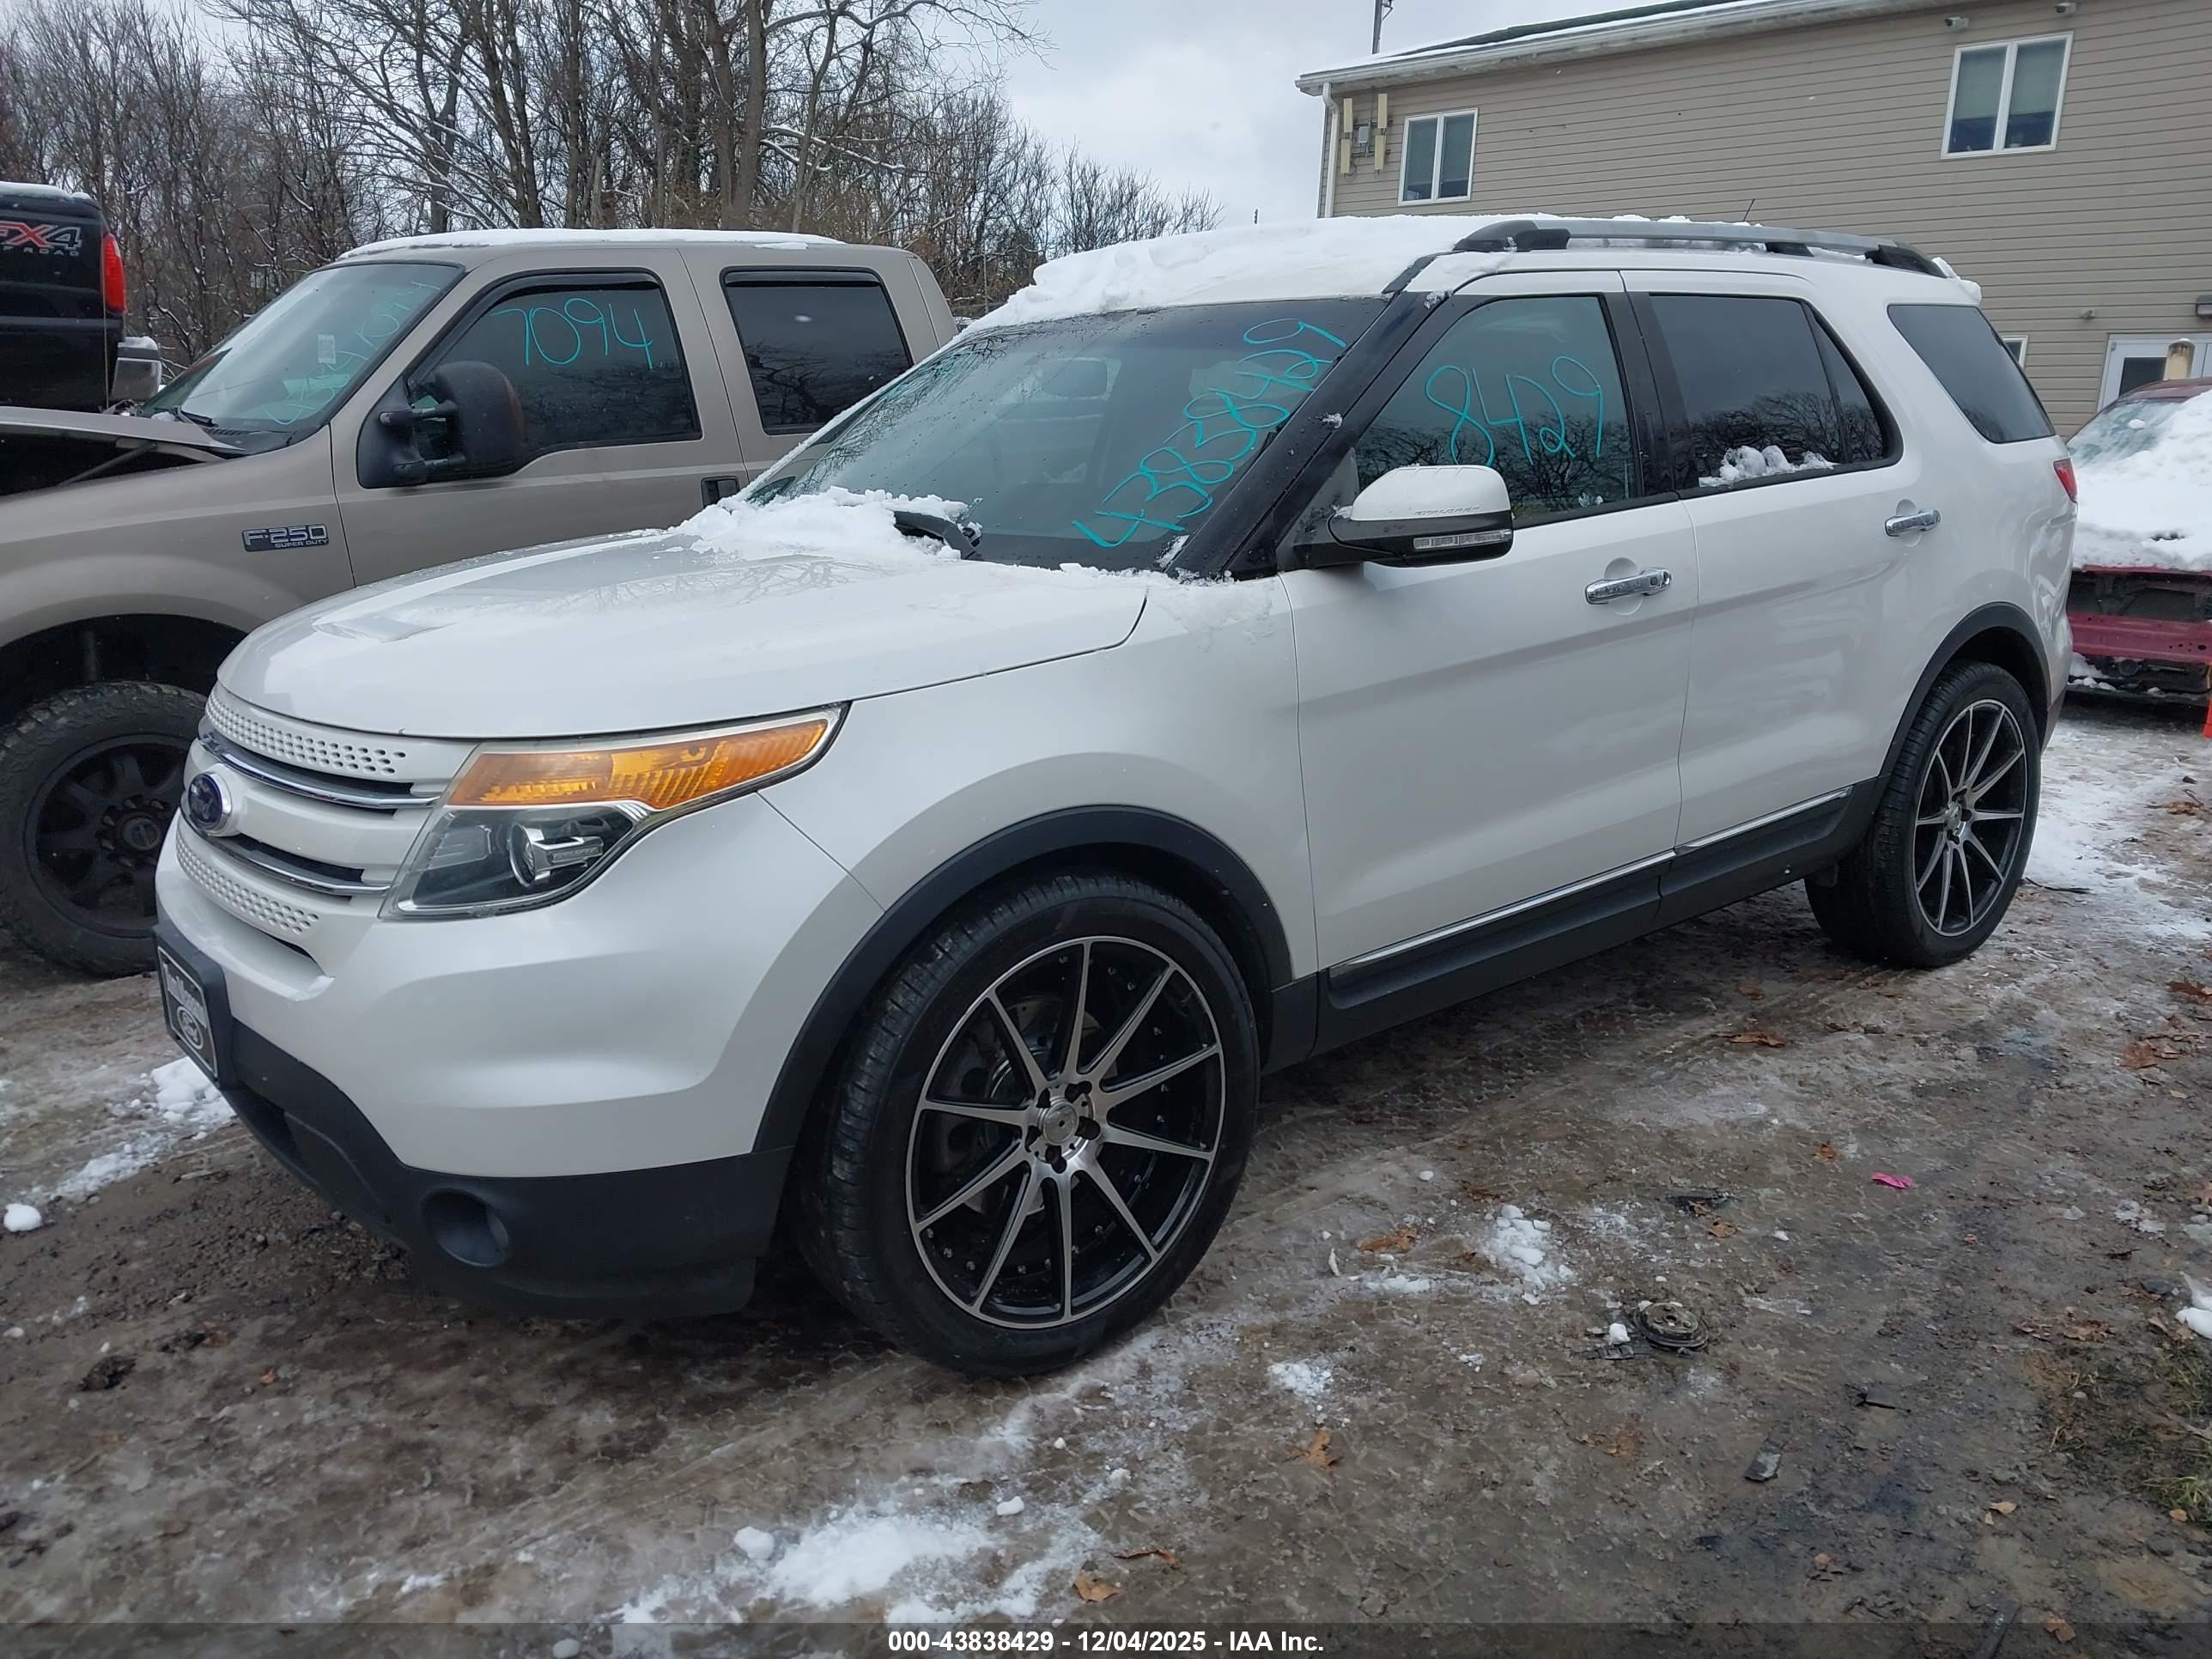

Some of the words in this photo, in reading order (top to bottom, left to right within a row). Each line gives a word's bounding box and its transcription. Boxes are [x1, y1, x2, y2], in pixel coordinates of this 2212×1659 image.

[489, 297, 654, 371] 7094
[1071, 318, 1347, 548] 43838429
[1425, 355, 1605, 467] 8429
[274, 540, 304, 549] SUPER
[305, 538, 329, 546] DUTY
